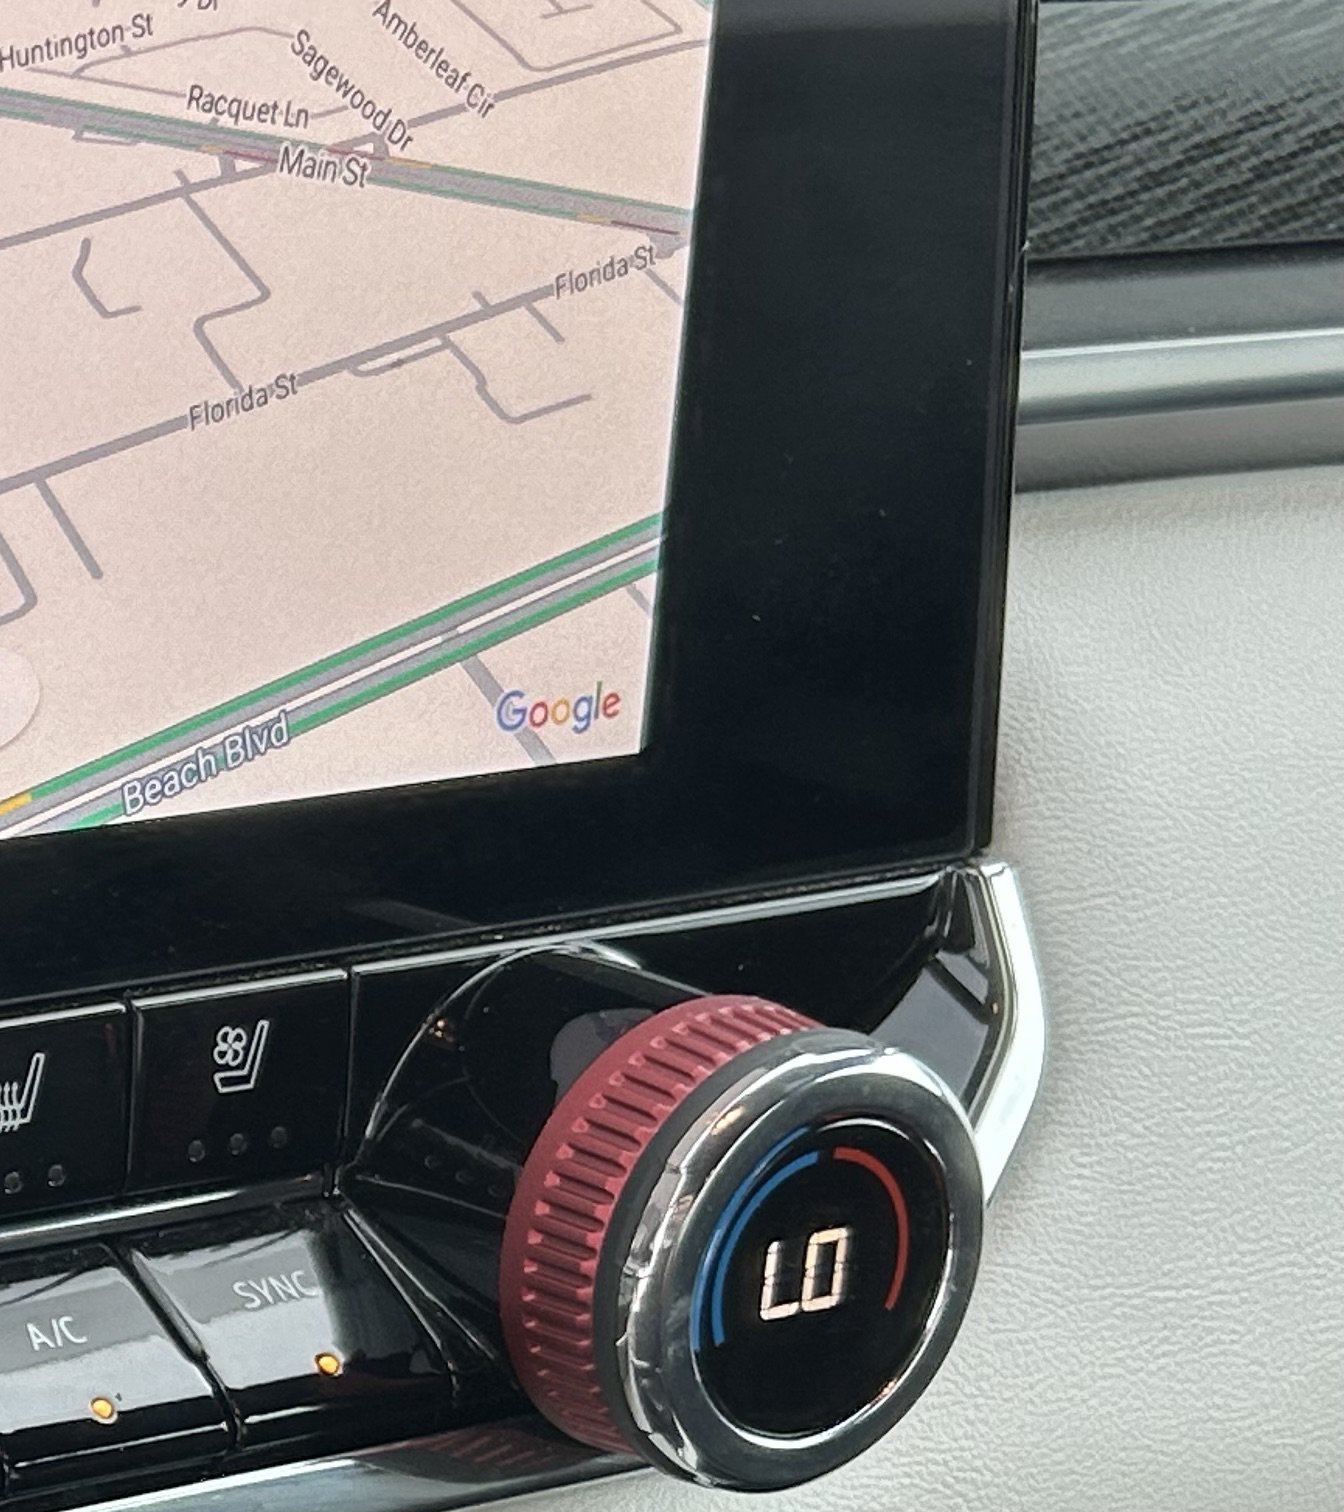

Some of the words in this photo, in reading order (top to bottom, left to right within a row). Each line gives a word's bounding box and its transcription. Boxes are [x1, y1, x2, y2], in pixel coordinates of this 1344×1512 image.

[132, 13, 154, 38] St
[372, 0, 471, 92] Amberleaf
[466, 83, 494, 118] Cir
[187, 84, 279, 128] Racquet
[284, 102, 310, 129] Ln
[291, 29, 395, 134] Sagewood
[386, 118, 414, 151] Dr
[279, 146, 338, 182] Main
[342, 156, 368, 188] St
[555, 256, 629, 299] Florida
[633, 245, 656, 271] St
[188, 385, 269, 431] Florida
[274, 373, 298, 400] St
[496, 681, 621, 734] Google
[120, 748, 219, 817] Beach
[222, 708, 291, 771] Blvd
[231, 1270, 322, 1310] SYNC
[759, 1226, 850, 1322] LO
[25, 1315, 88, 1352] A/C
